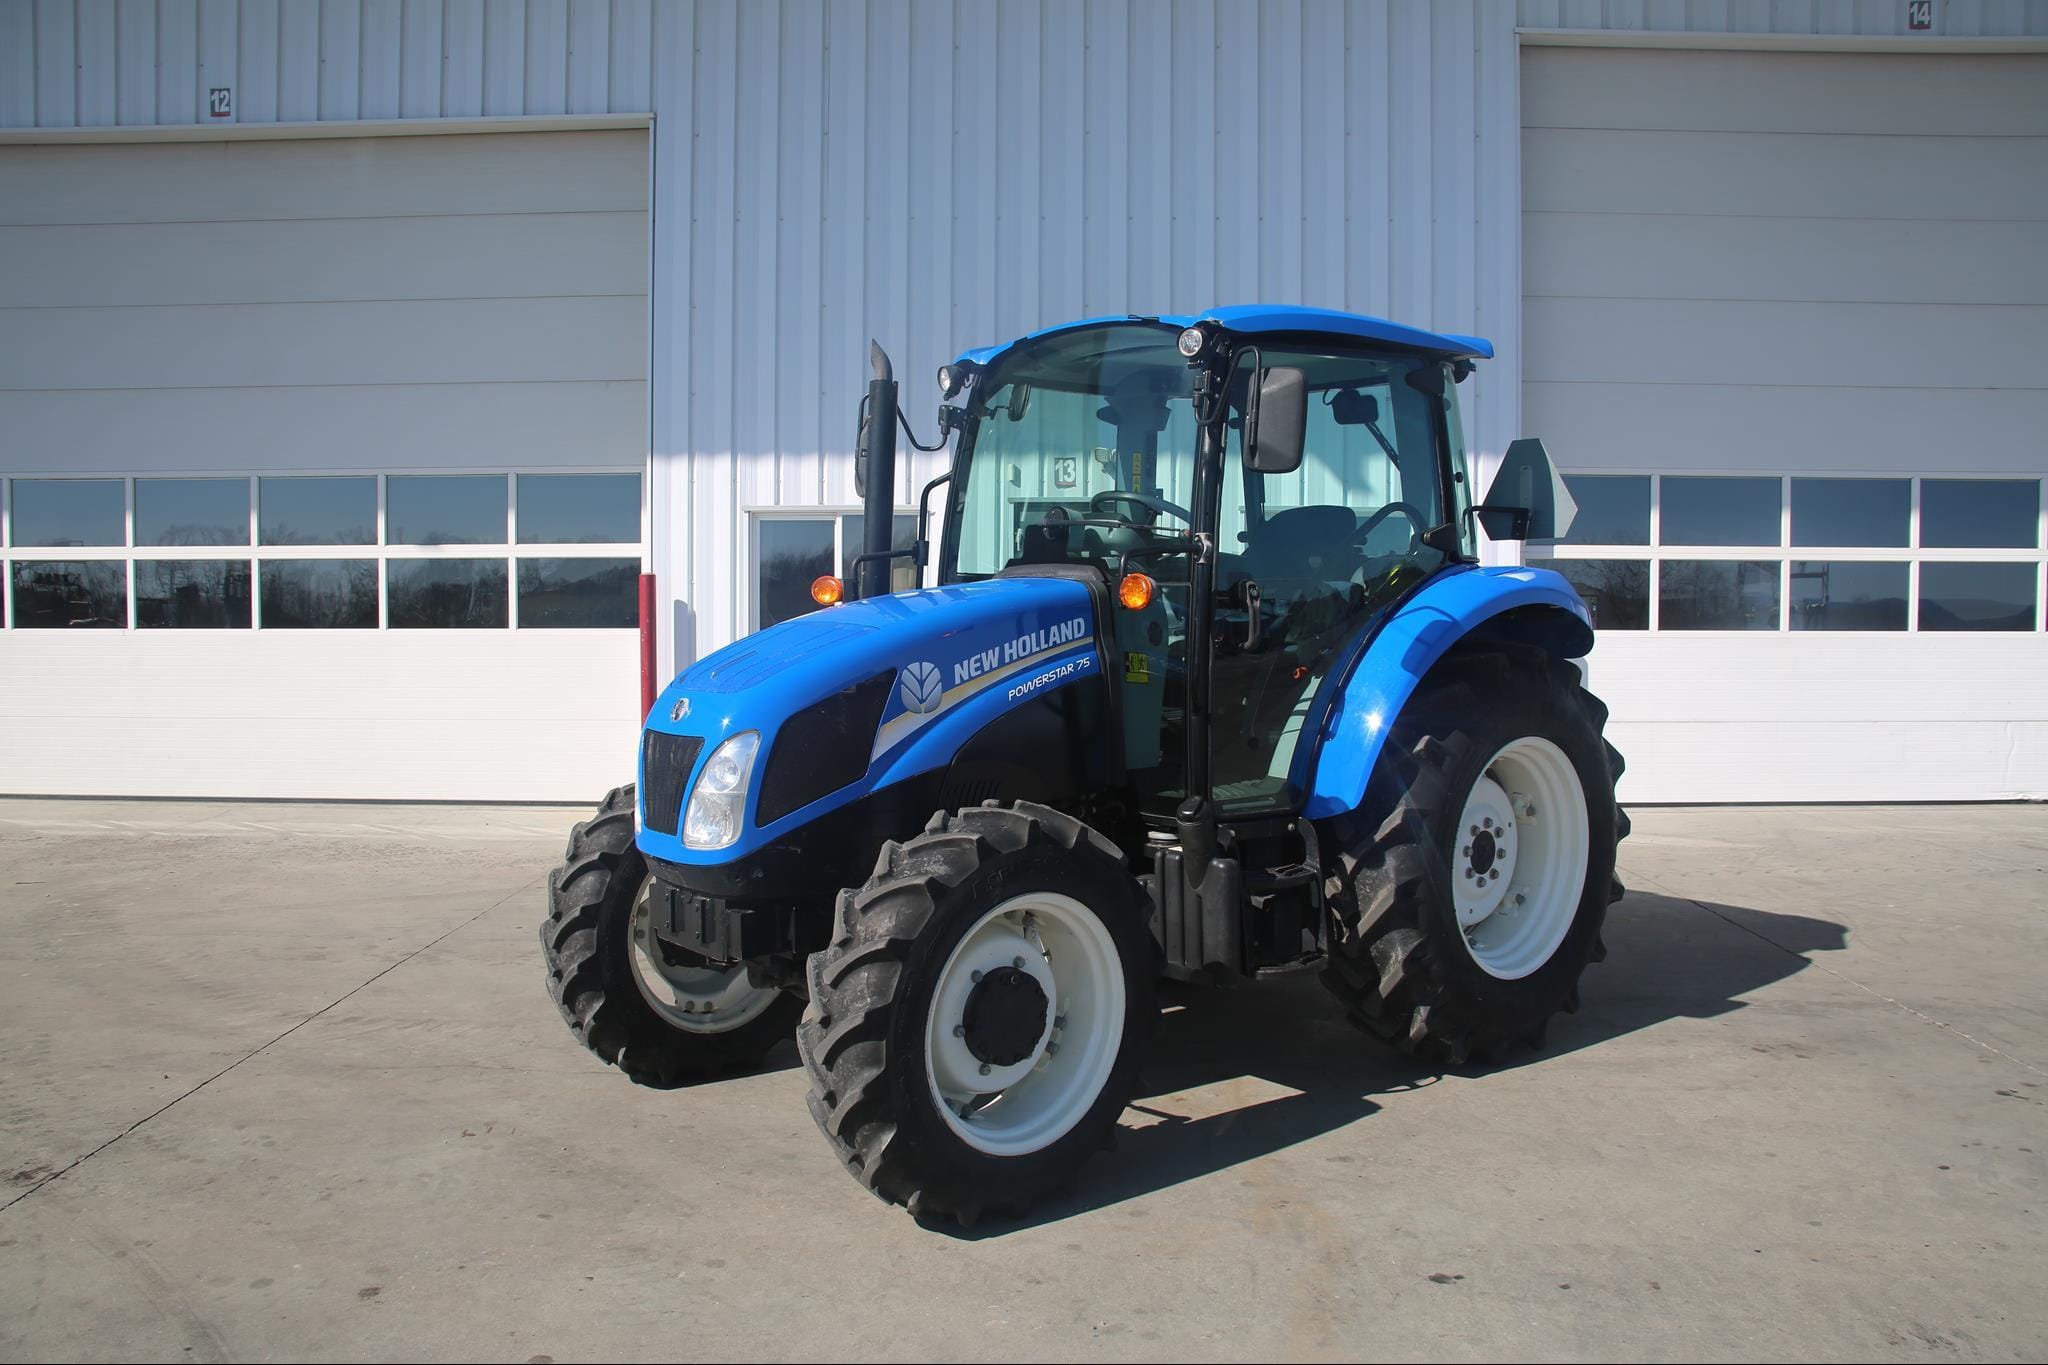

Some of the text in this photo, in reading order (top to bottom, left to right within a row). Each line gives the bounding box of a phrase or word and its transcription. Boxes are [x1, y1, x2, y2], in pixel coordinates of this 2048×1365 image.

[1910, 3, 1930, 25] 14
[211, 90, 230, 113] 12
[1055, 459, 1076, 483] 13
[954, 617, 1086, 685] NEW HOLLAND
[1008, 657, 1090, 701] POWERSTAR 75
